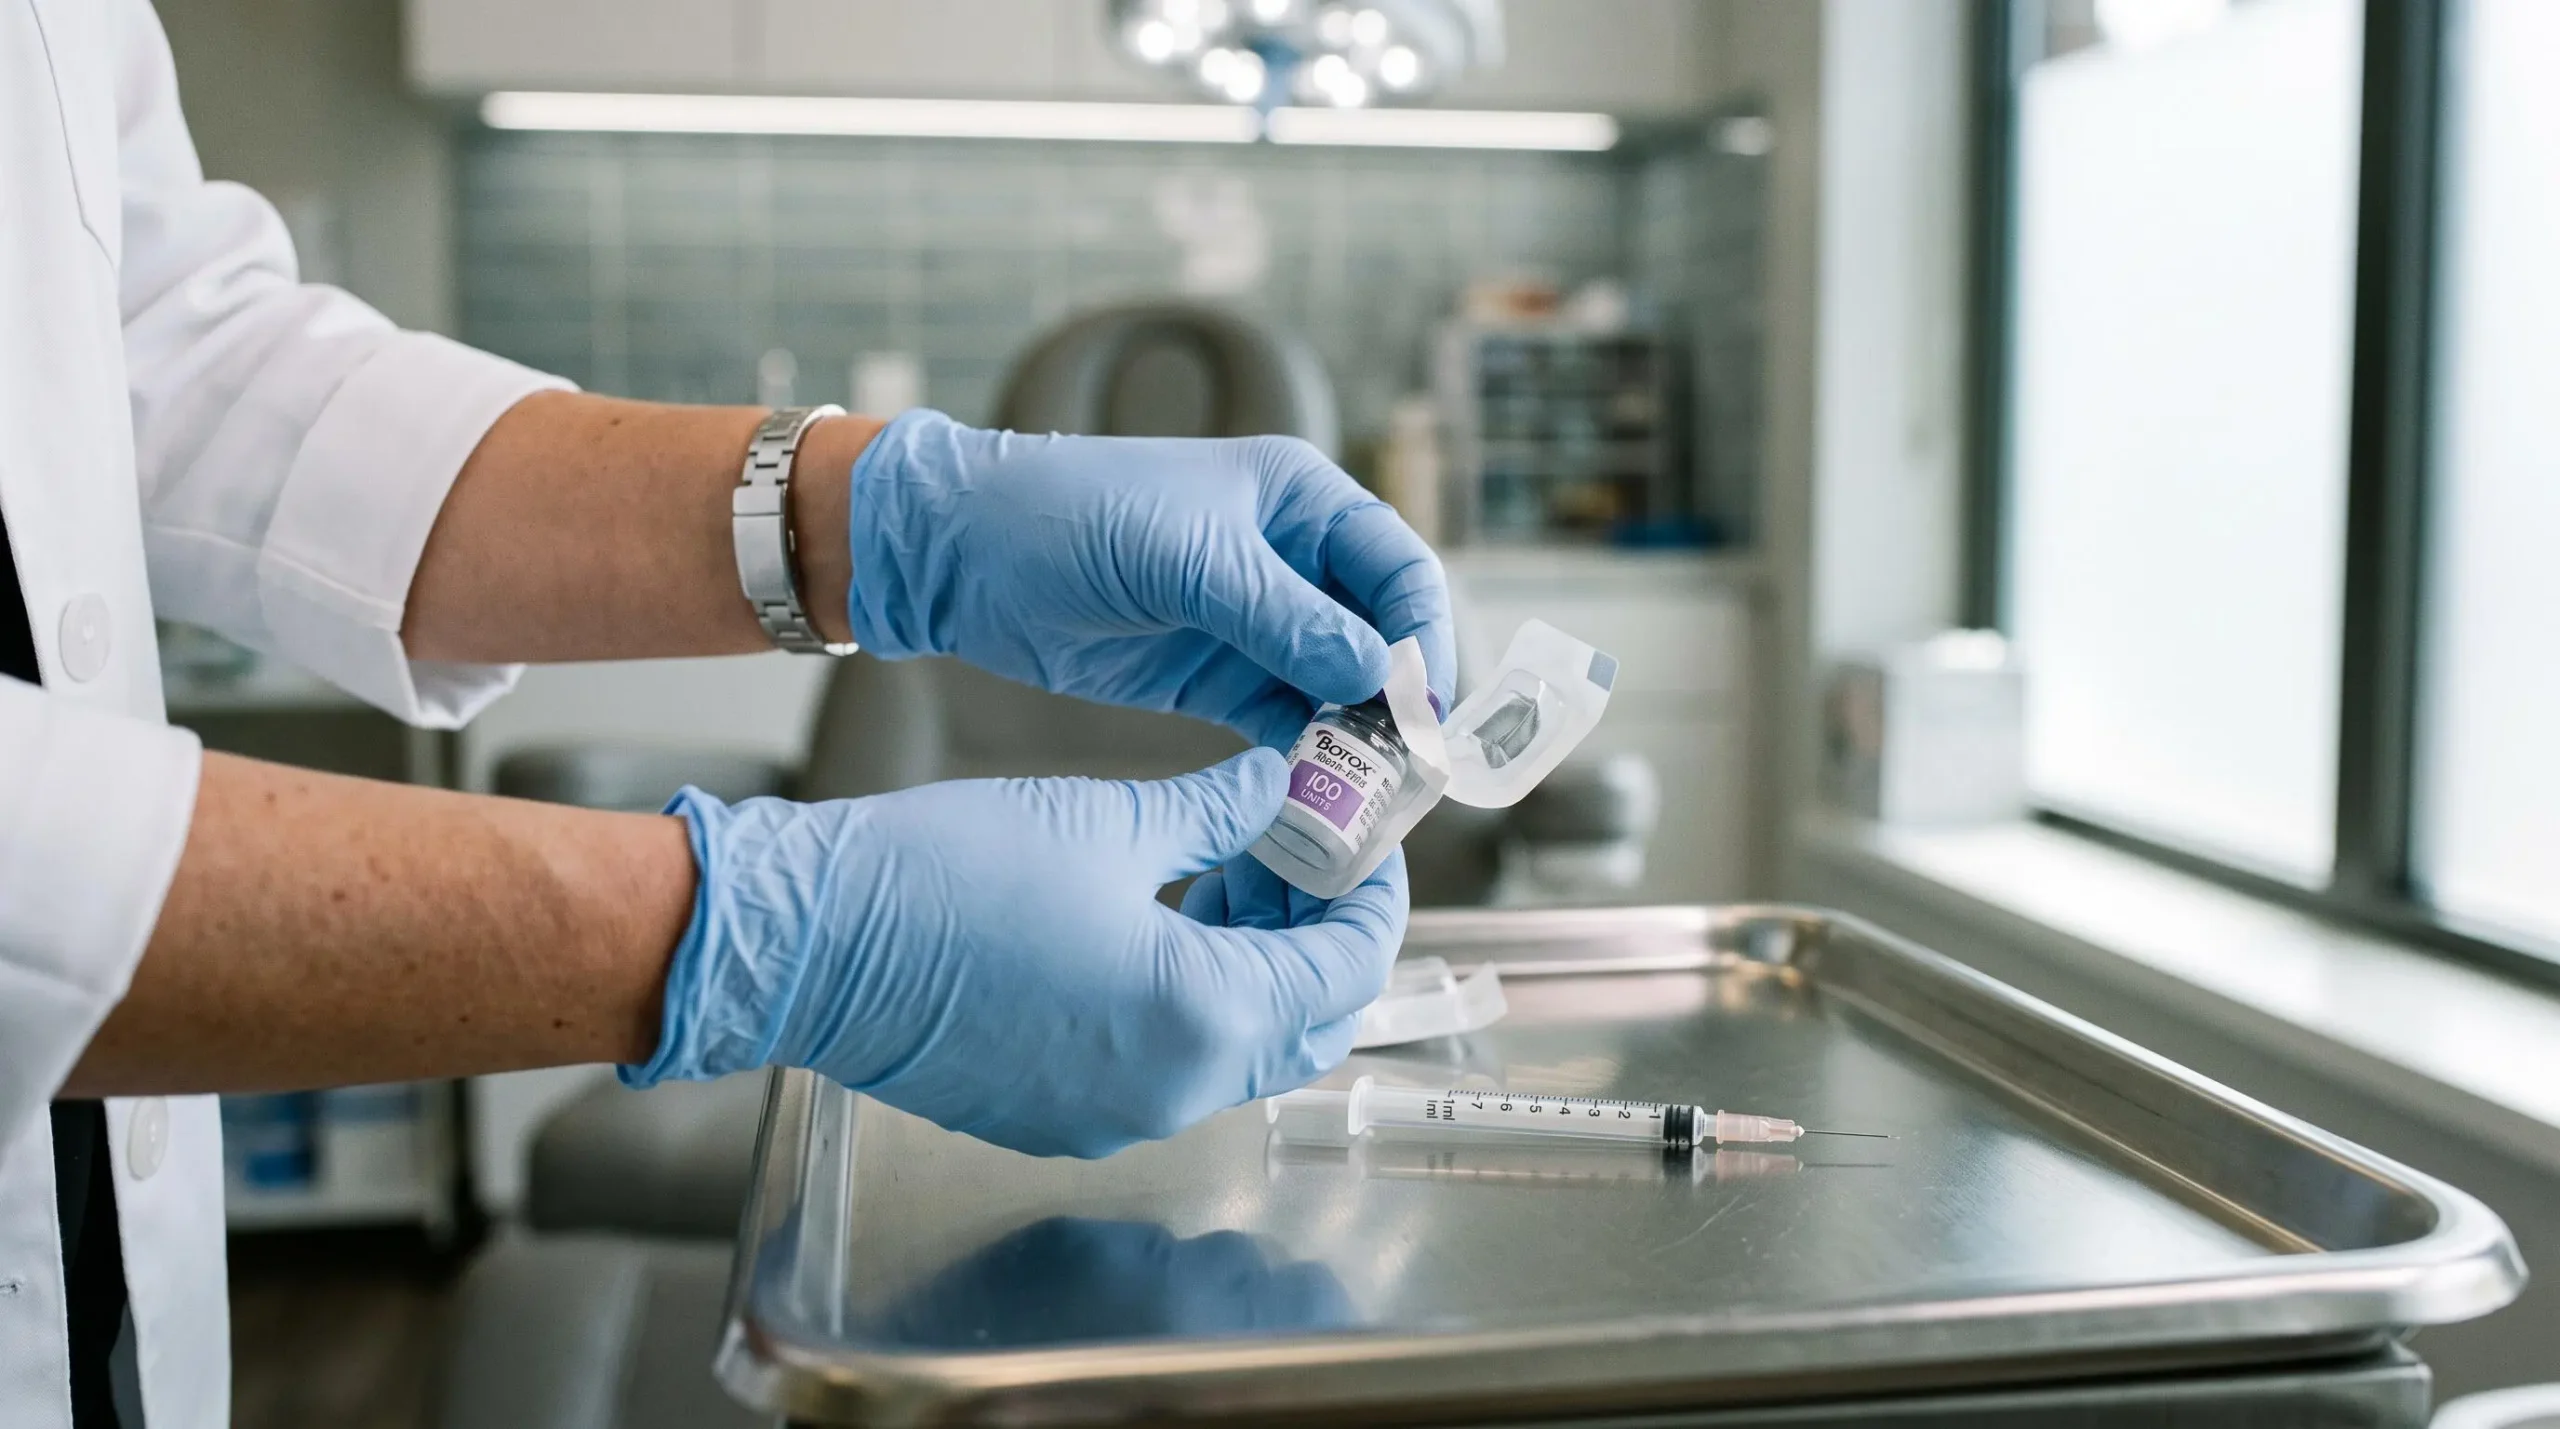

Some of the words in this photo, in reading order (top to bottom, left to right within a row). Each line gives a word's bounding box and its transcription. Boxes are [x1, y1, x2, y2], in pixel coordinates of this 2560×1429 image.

[1316, 736, 1372, 776] BOTOX
[1306, 771, 1342, 801] 100
[1301, 788, 1332, 811] UNITS
[1443, 1099, 1455, 1120] 1ml
[1471, 1102, 1483, 1110] 7
[1500, 1103, 1512, 1112] 6
[1529, 1105, 1542, 1113] 5
[1559, 1107, 1571, 1115] 4
[1588, 1108, 1600, 1117] 3
[1618, 1111, 1631, 1119] 2
